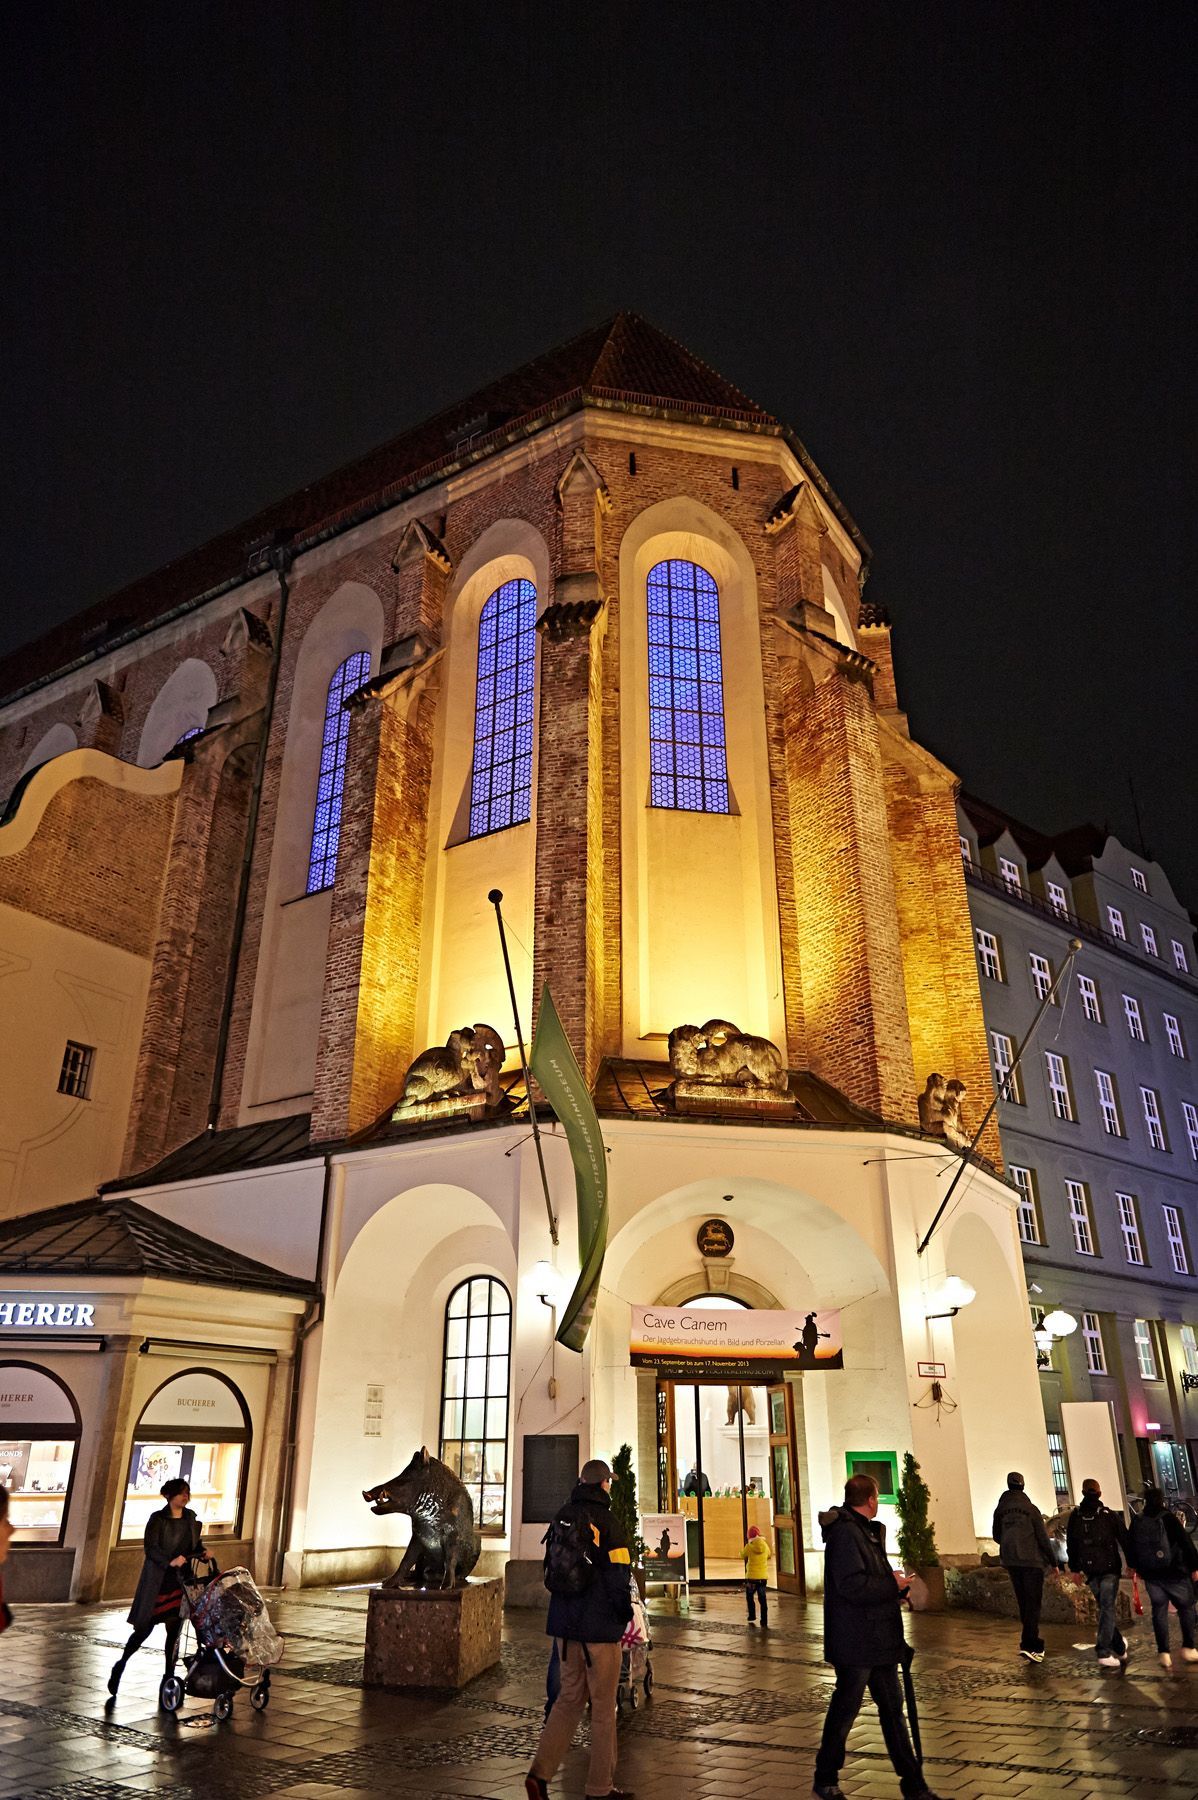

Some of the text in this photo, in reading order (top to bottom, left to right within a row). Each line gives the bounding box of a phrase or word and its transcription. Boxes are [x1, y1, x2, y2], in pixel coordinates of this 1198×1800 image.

[0, 1303, 95, 1327] HERER
[643, 1313, 728, 1331] Cave Canem
[642, 1334, 656, 1343] Der
[657, 1335, 718, 1346] Jagdgebrauchshund
[727, 1338, 740, 1346] Bild
[741, 1338, 754, 1346] und
[755, 1338, 785, 1346] Porzellan
[177, 1398, 216, 1408] BUCHERER
